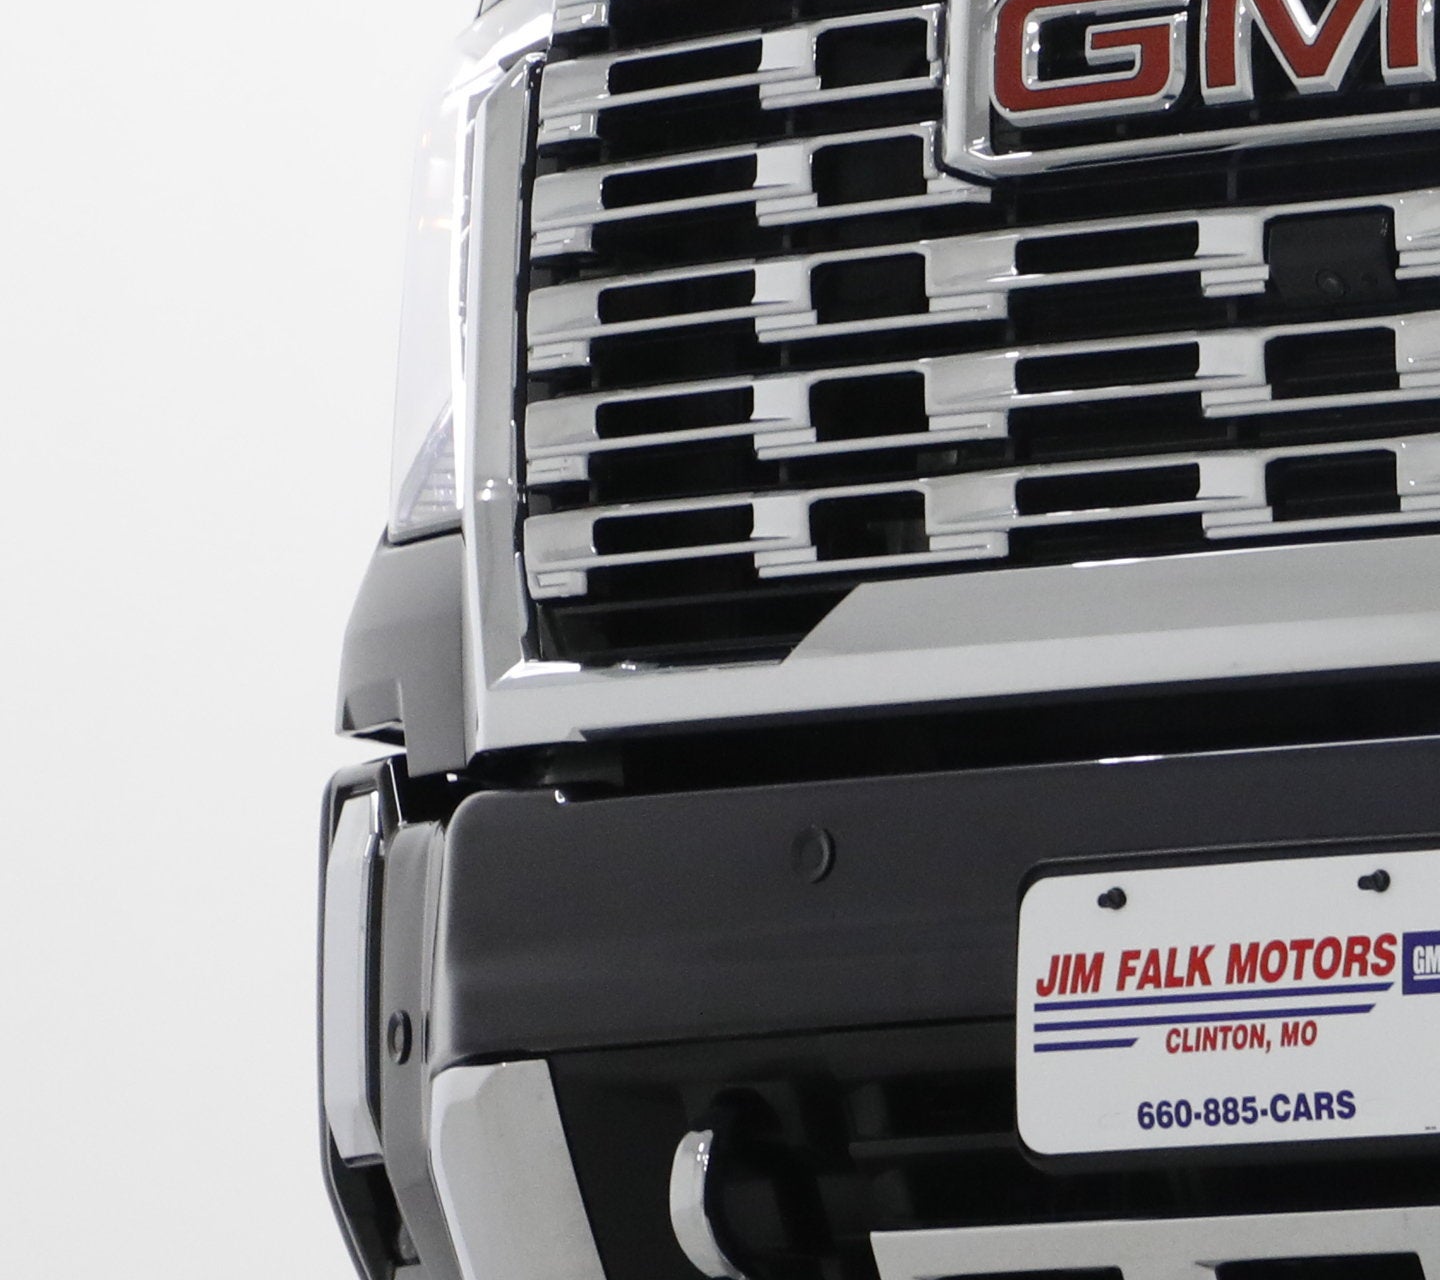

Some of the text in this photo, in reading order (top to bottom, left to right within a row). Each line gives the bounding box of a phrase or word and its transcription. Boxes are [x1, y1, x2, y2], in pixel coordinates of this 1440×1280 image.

[1036, 932, 1398, 998] JIM FALK MOTORS
[1165, 1020, 1318, 1054] CLINTON, MO
[1137, 1090, 1357, 1130] 660-885-CARS
